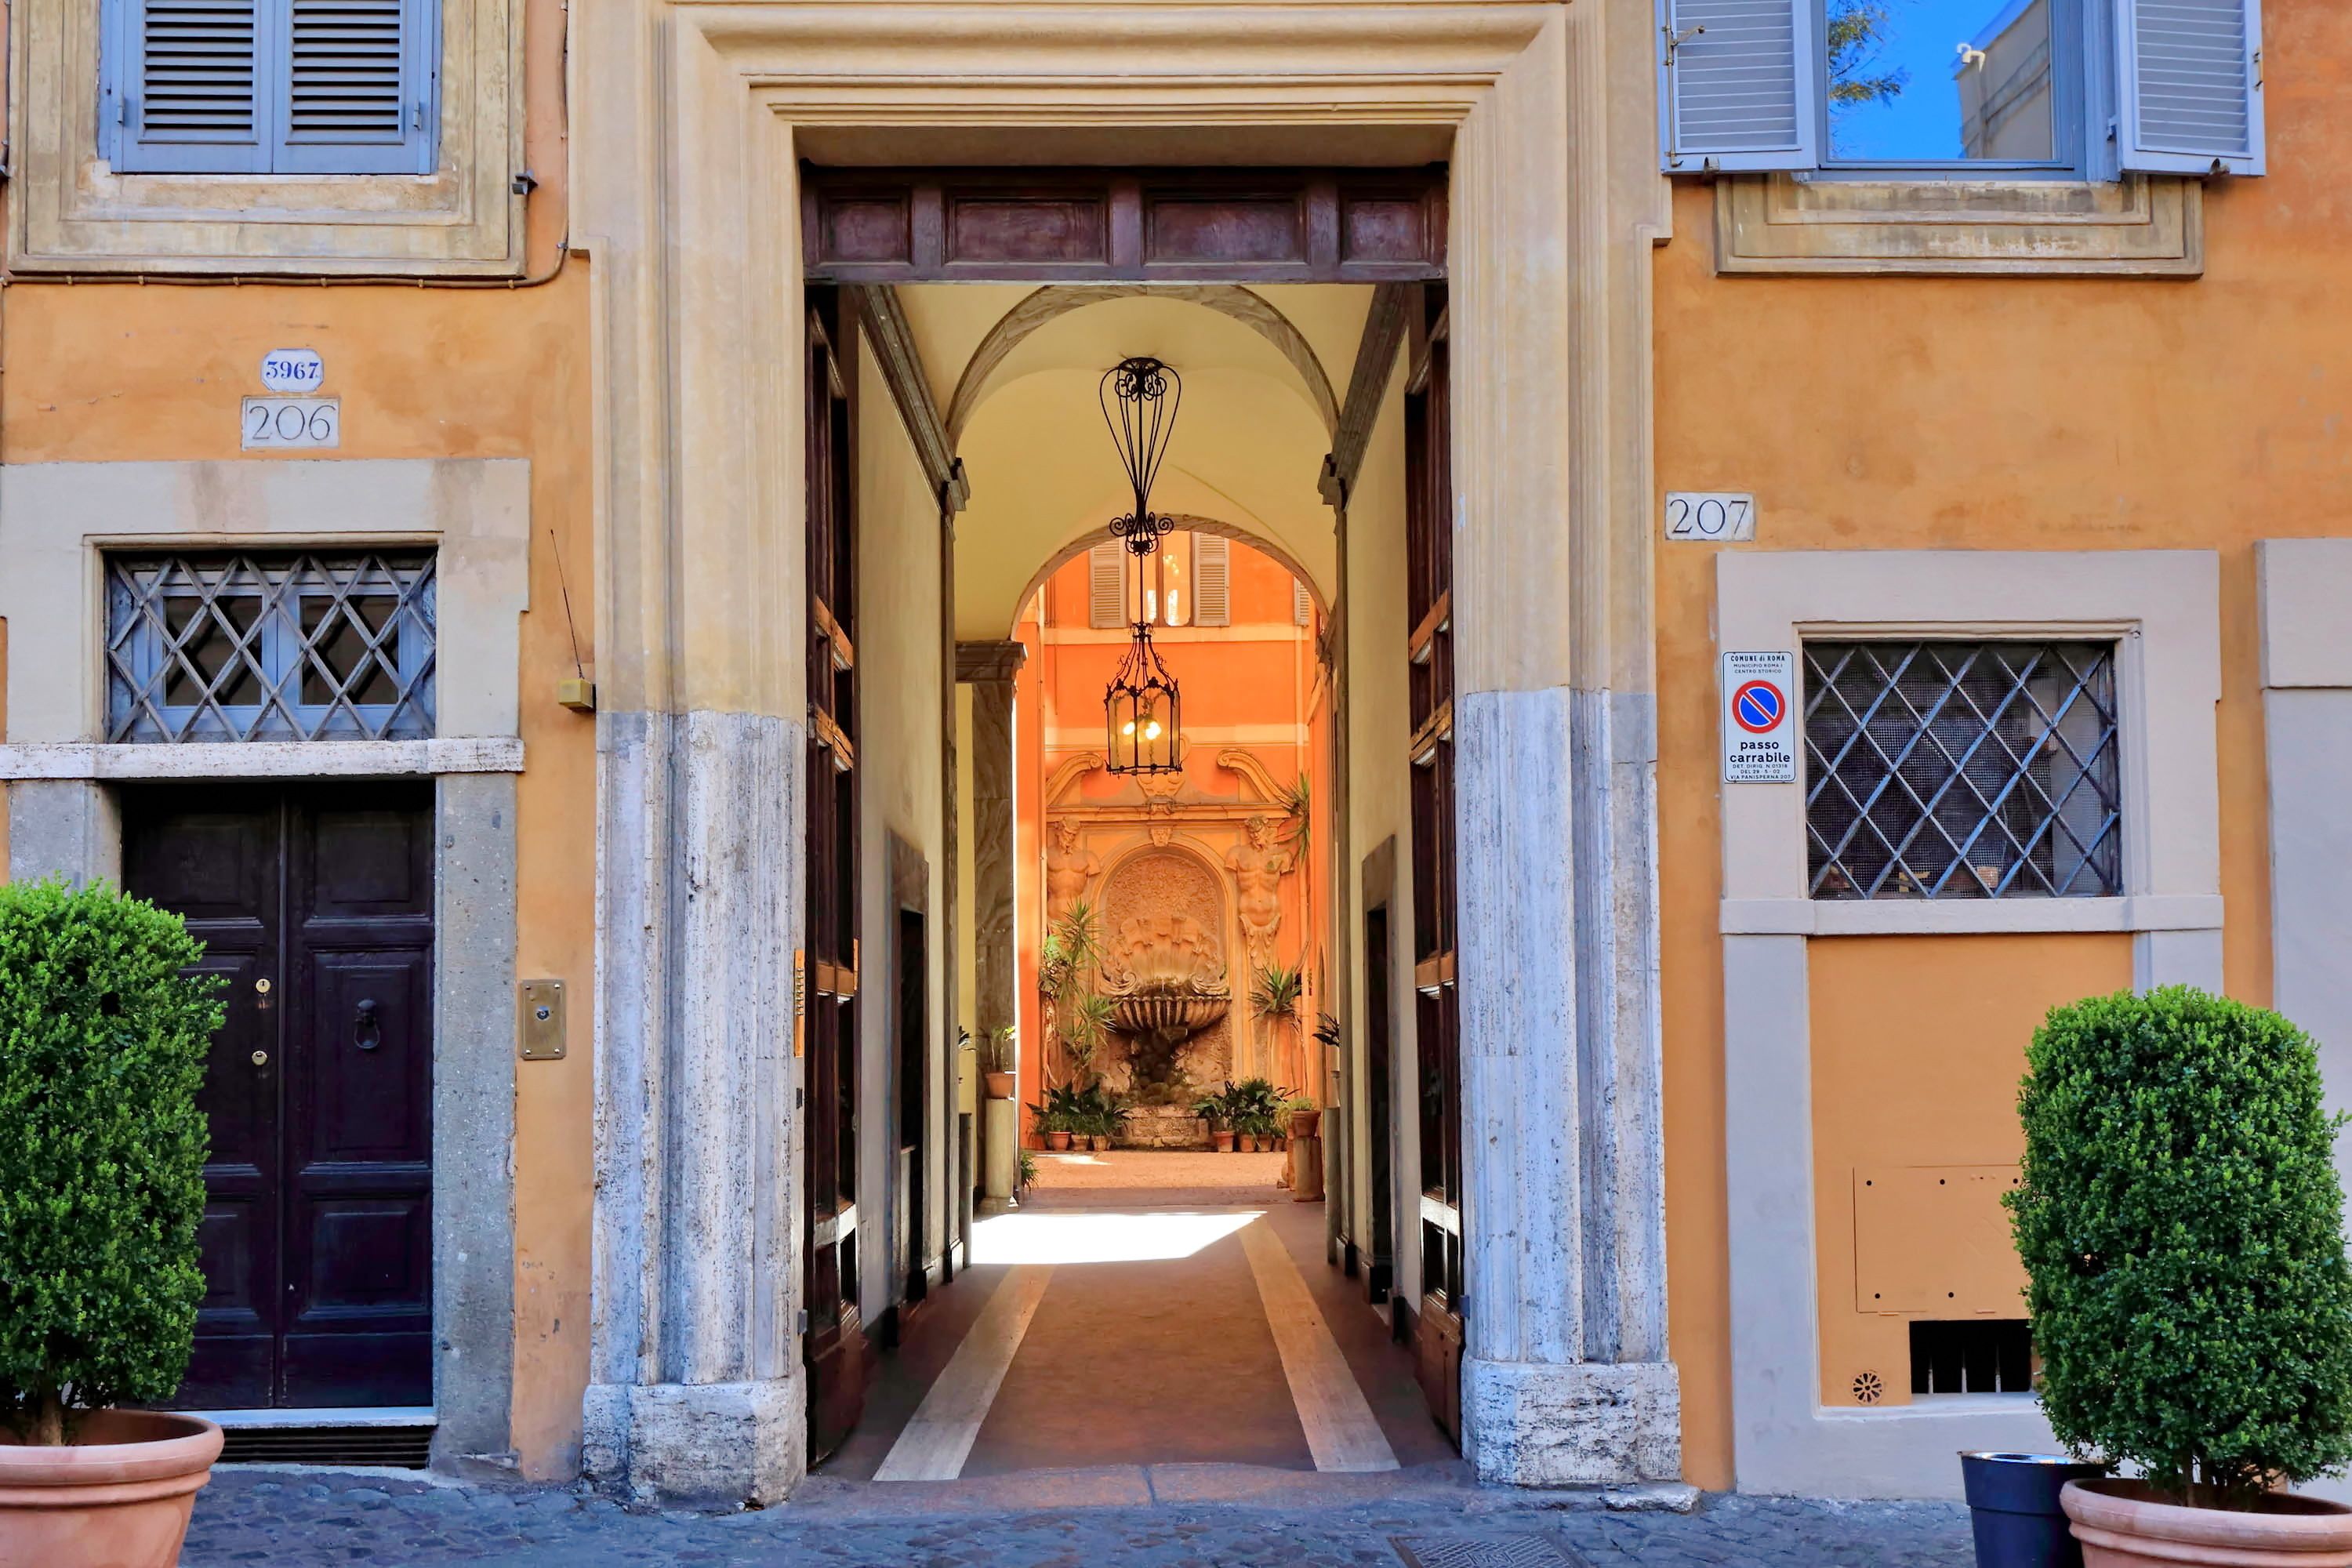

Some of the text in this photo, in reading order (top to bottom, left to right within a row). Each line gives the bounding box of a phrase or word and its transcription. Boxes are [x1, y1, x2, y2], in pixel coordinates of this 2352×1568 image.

[249, 405, 336, 440] 206
[1669, 499, 1748, 535] 207
[1730, 752, 1791, 763] carrabile
[1740, 741, 1779, 751] passo
